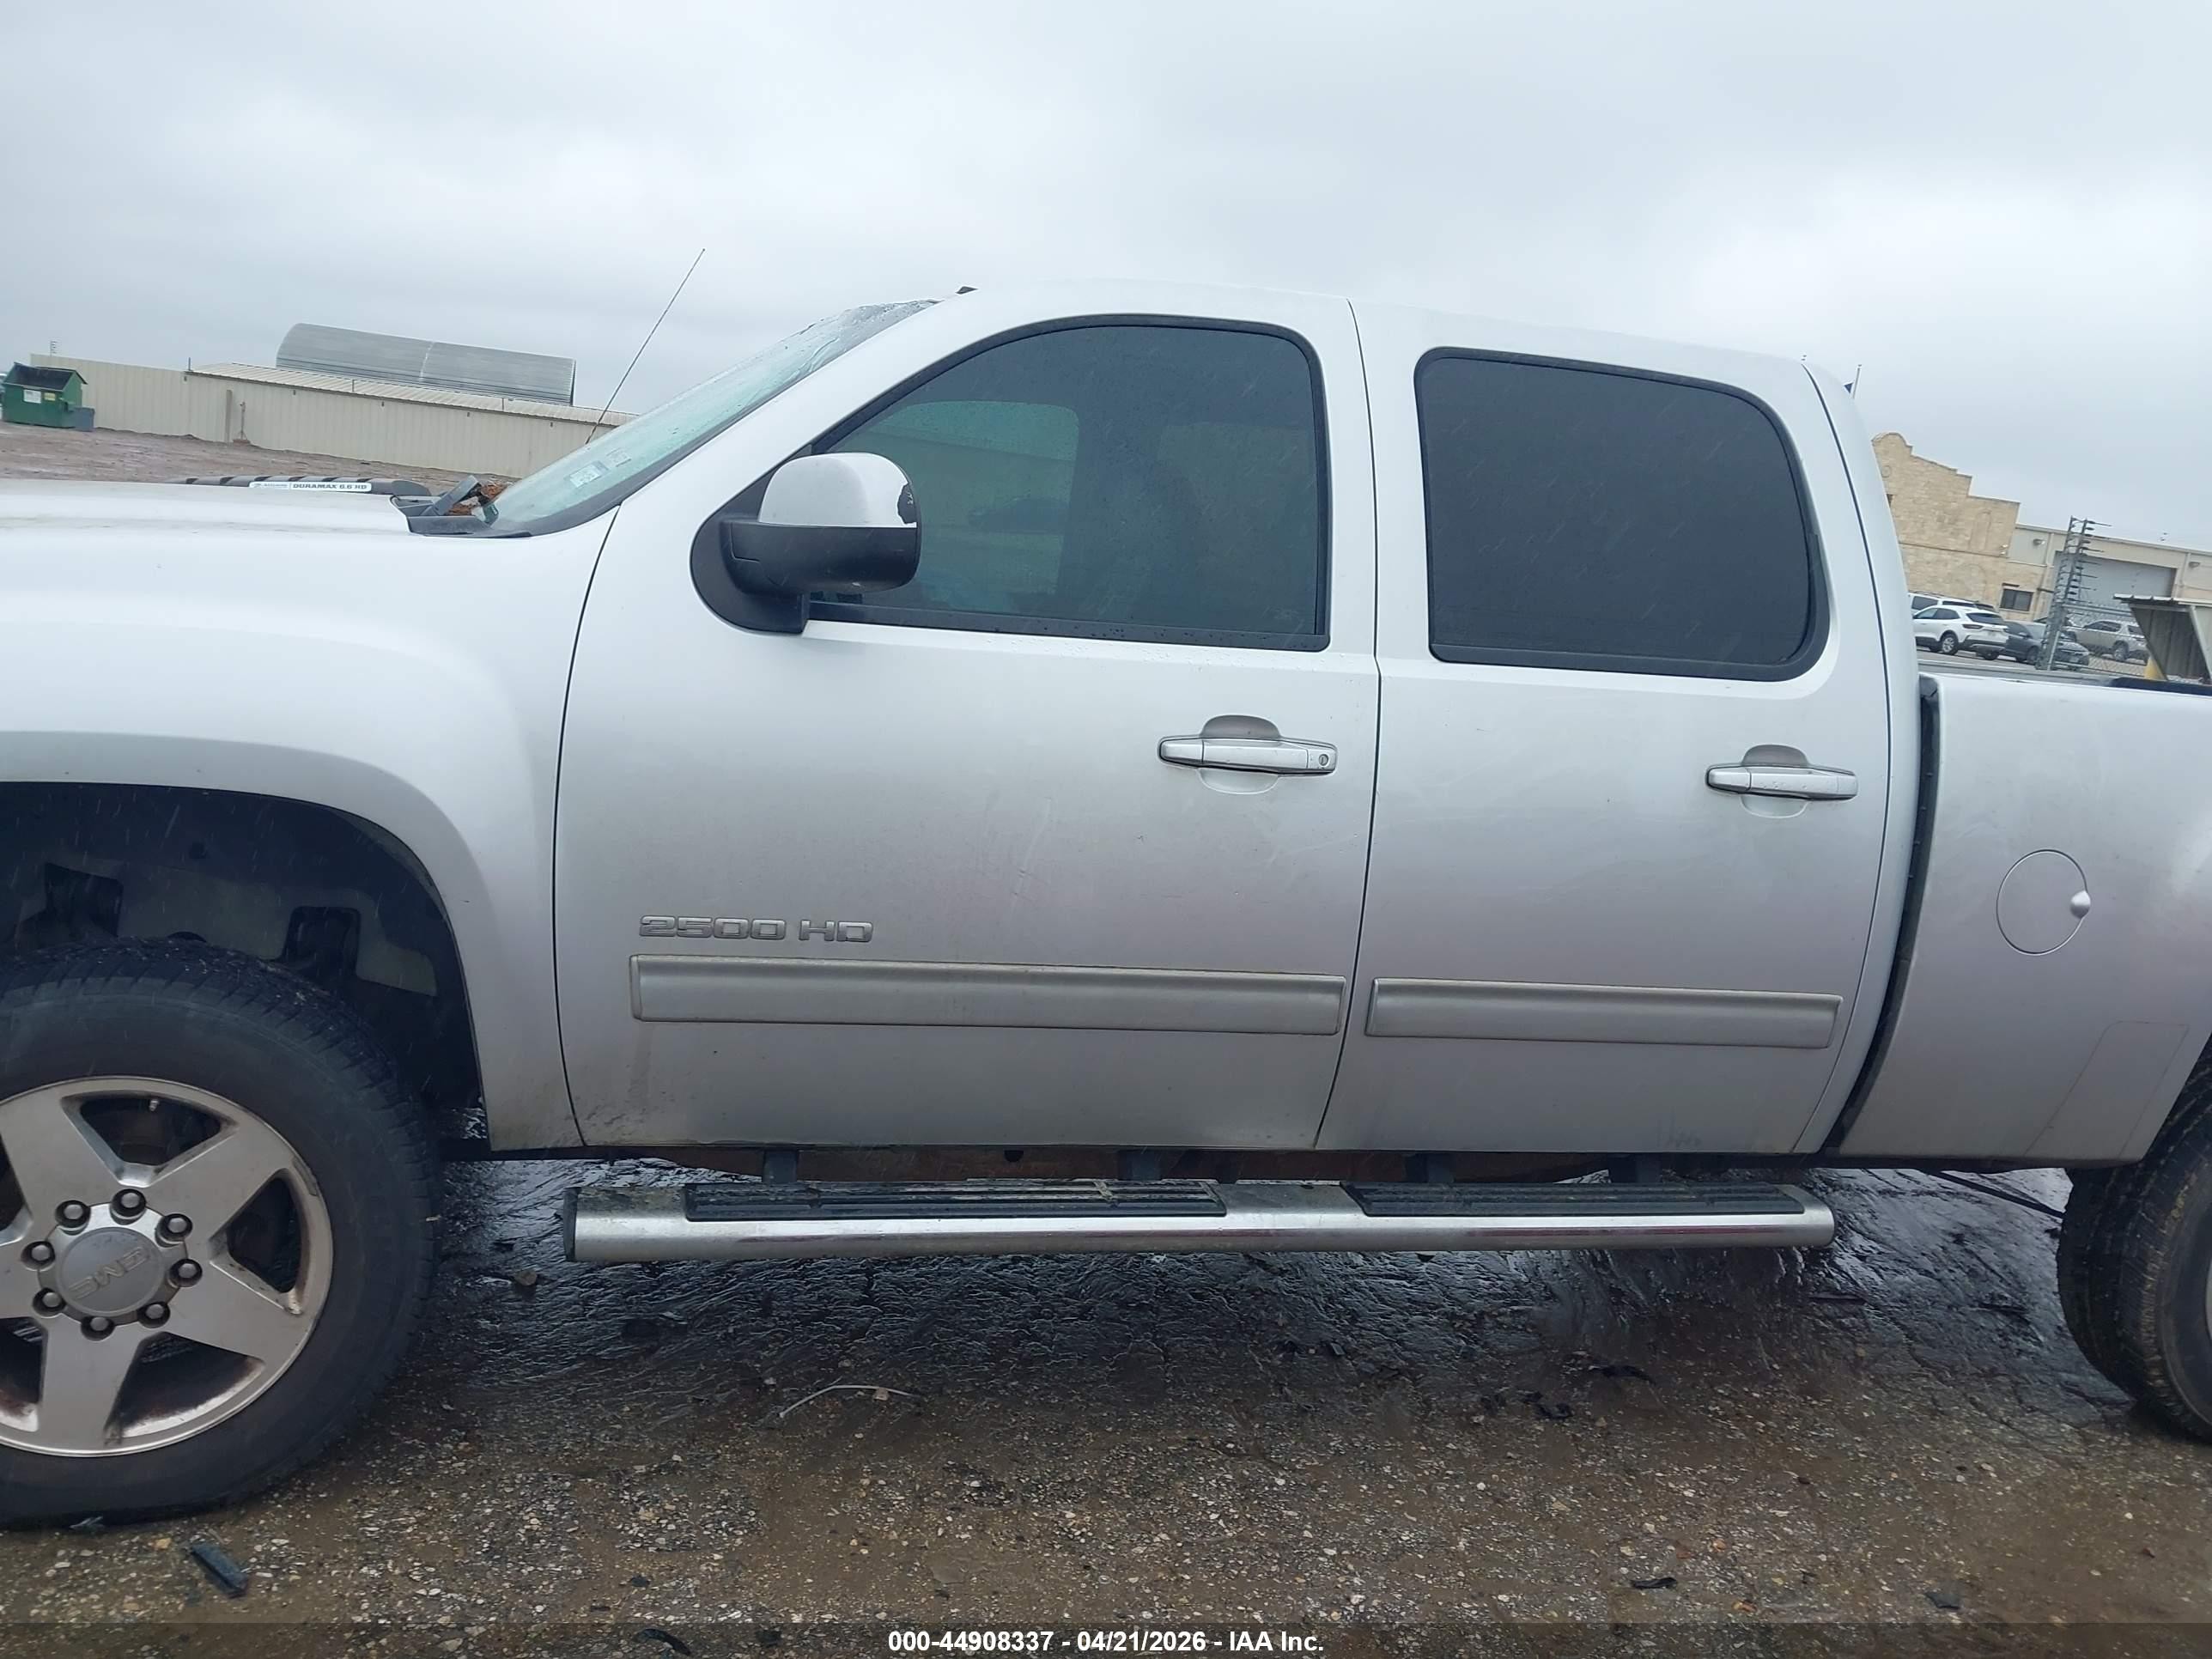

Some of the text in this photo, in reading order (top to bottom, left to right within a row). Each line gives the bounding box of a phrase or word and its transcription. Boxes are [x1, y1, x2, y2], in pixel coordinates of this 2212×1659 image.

[639, 915, 874, 943] 2500 HD
[68, 1245, 150, 1300] GMC
